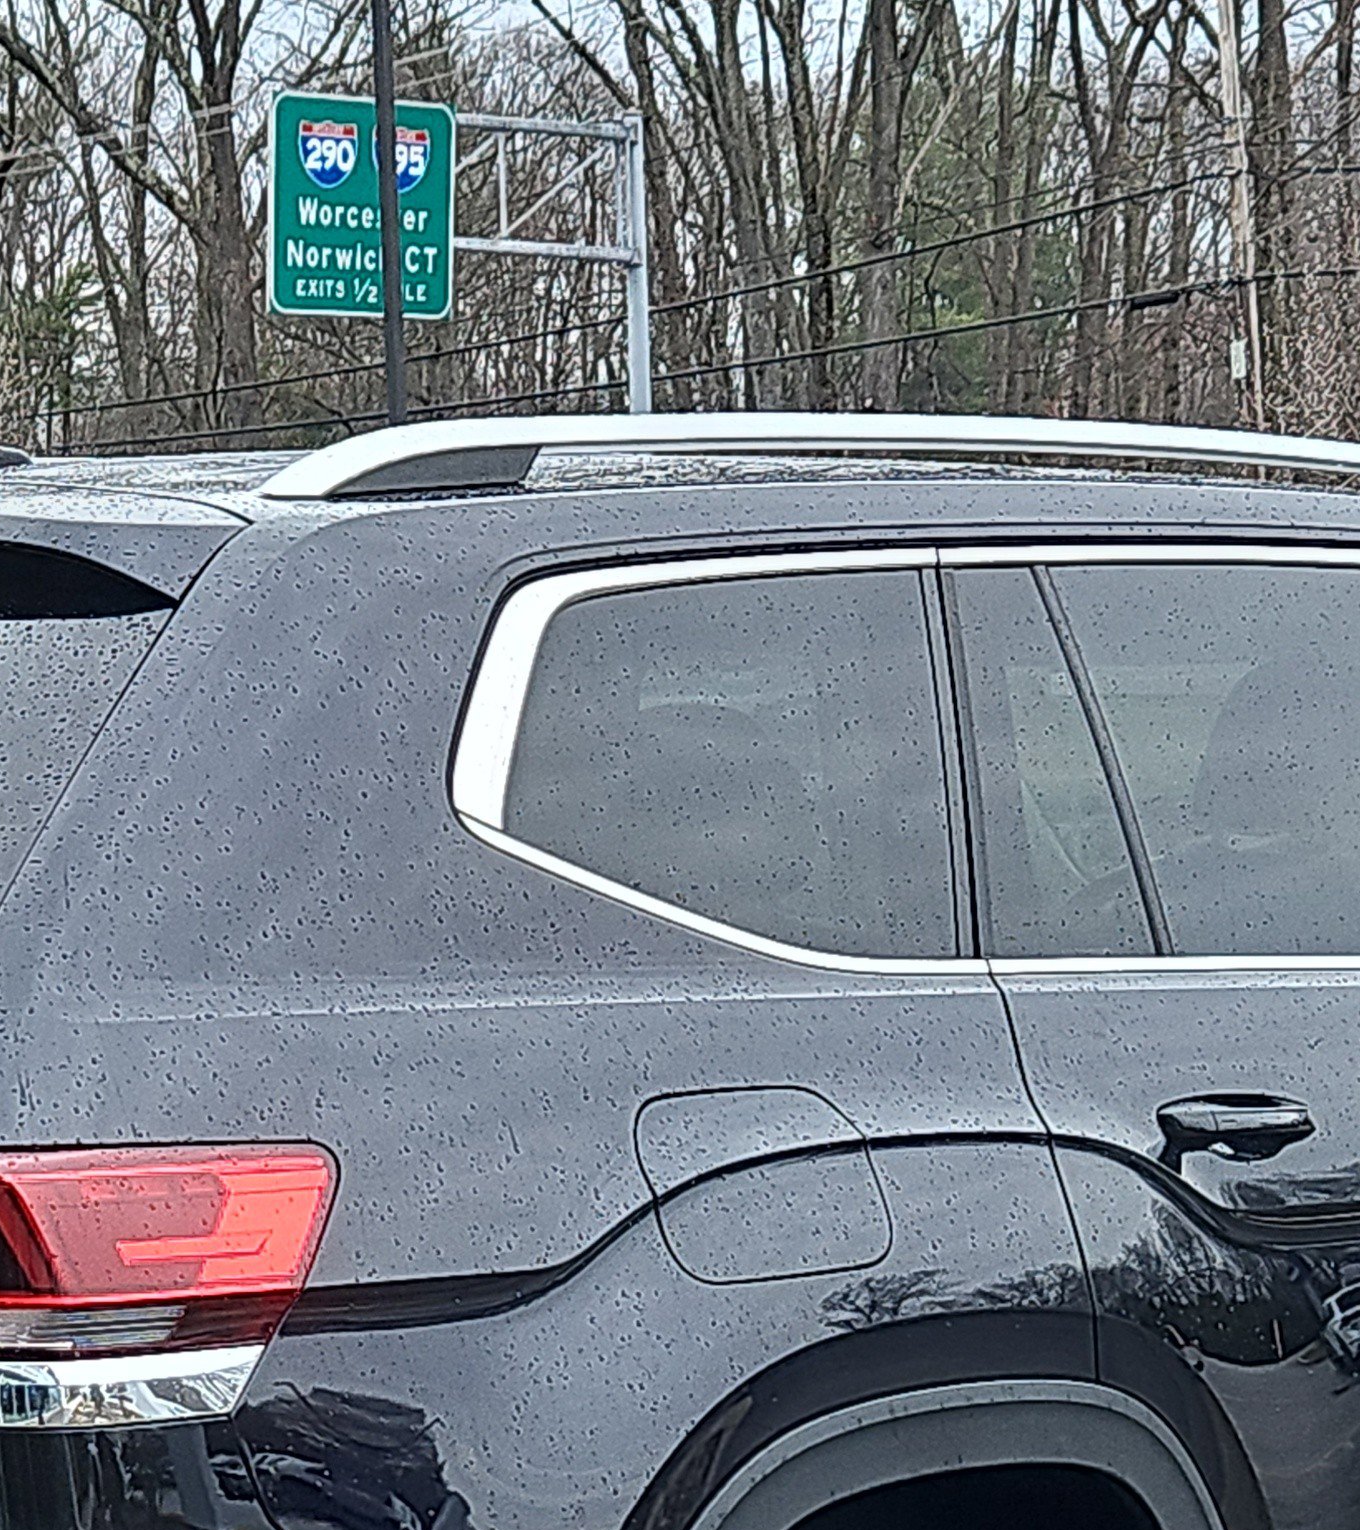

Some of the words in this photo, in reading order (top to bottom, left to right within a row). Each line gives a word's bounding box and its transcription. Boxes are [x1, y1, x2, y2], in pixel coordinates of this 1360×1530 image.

[304, 137, 356, 172] 290
[298, 196, 428, 233] Worceer
[404, 245, 438, 274] CT
[295, 278, 346, 299] EXITS
